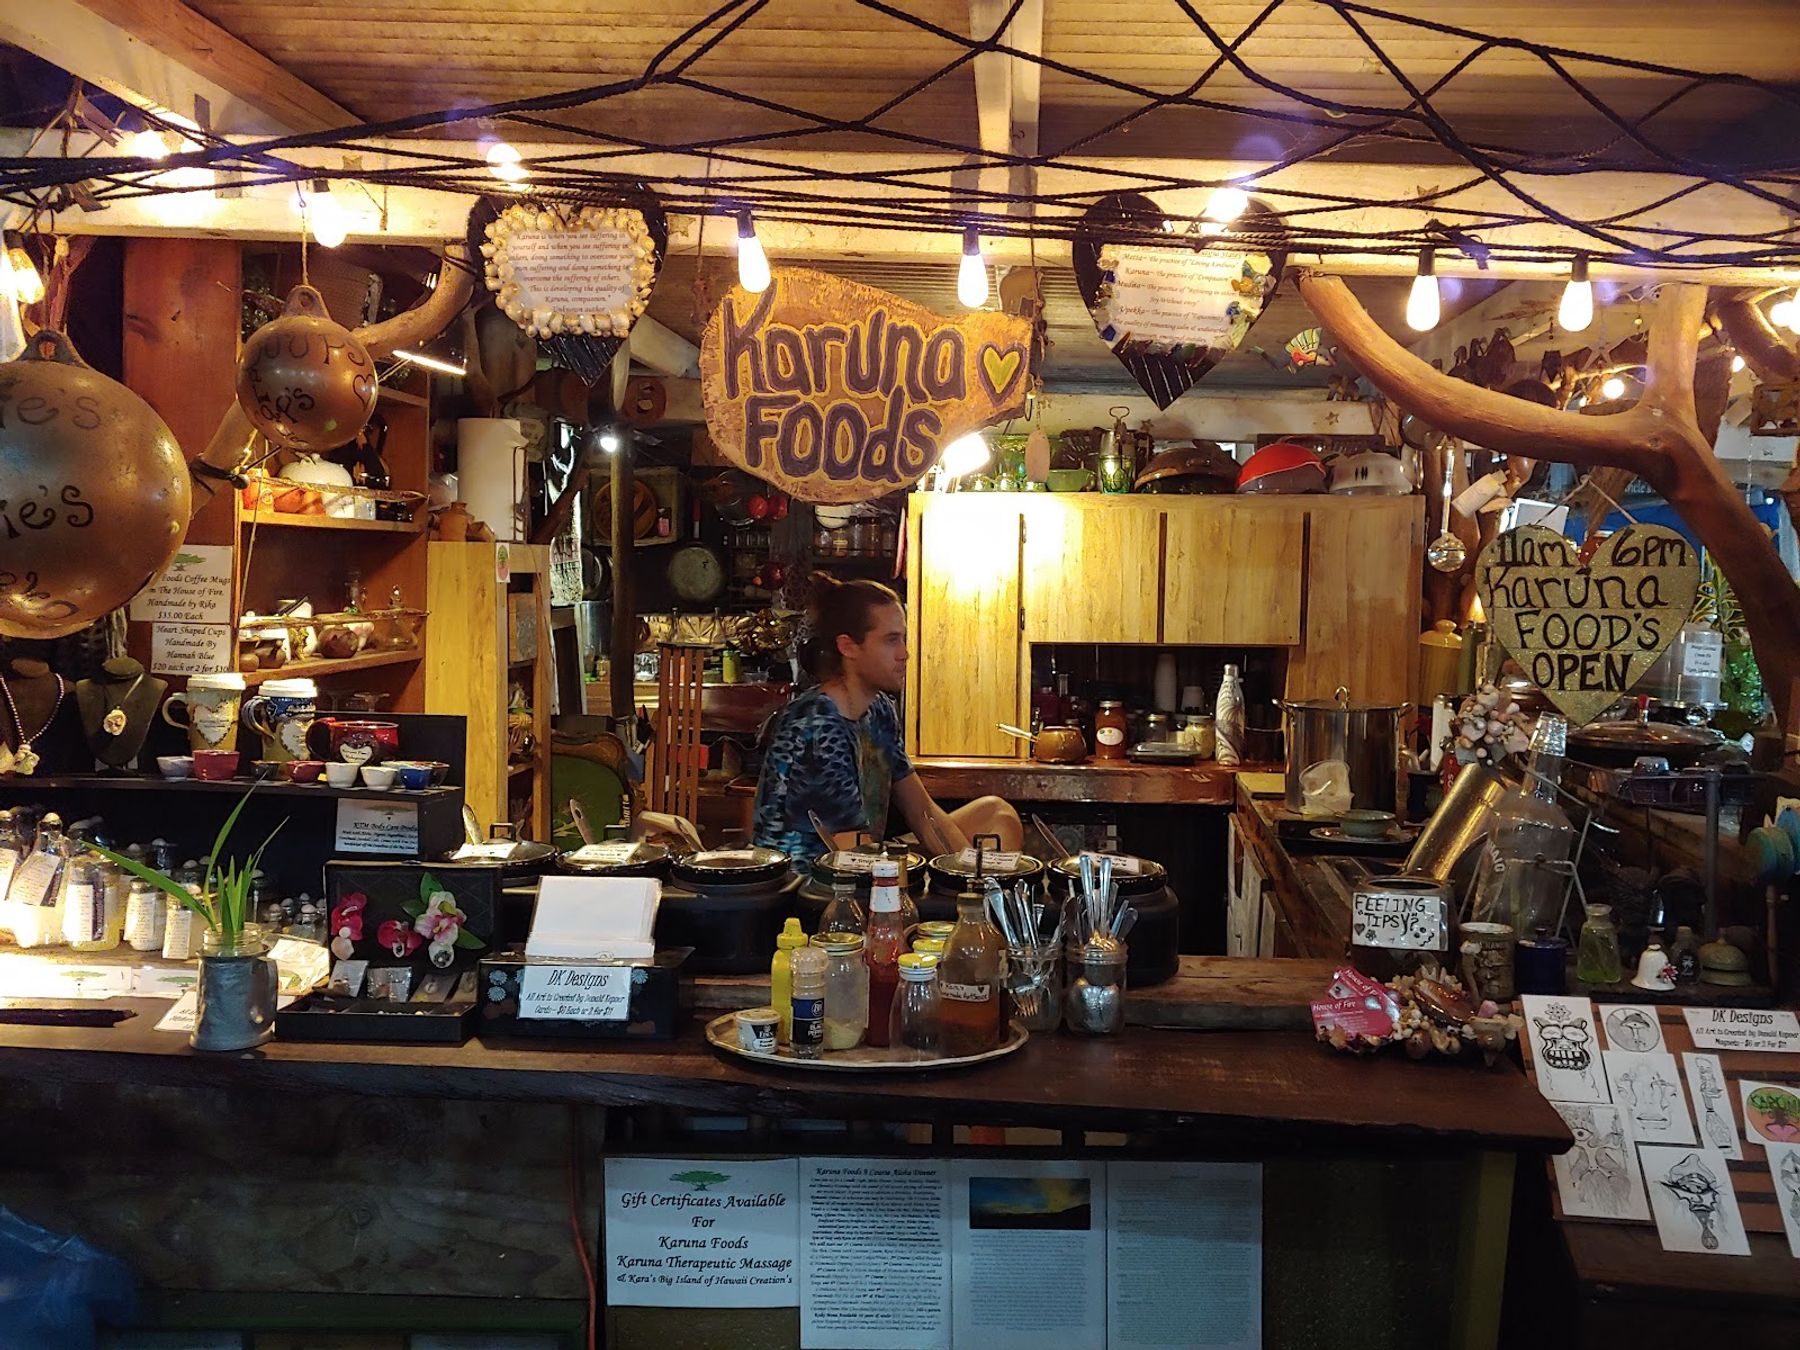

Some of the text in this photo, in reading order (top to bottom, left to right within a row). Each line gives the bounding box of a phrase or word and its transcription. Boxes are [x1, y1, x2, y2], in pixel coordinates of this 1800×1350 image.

[551, 242, 567, 250] when
[592, 241, 620, 251] suffering
[549, 252, 580, 261] something
[529, 263, 557, 273] suffering
[571, 264, 588, 272] doing
[590, 264, 621, 272] something
[564, 273, 591, 283] suffering
[592, 273, 600, 282] of
[529, 283, 542, 291] This
[550, 284, 583, 293] developing
[594, 283, 617, 293] quality
[722, 278, 967, 404] Karuna
[184, 574, 208, 584] Coffee
[209, 576, 231, 585] Mugs
[159, 586, 172, 594] The
[172, 587, 195, 596] House
[197, 588, 205, 597] of
[147, 599, 187, 608] Handmade
[187, 599, 197, 610] by
[184, 611, 203, 620] Each
[156, 625, 226, 638] Heart Shaped Cups
[164, 638, 217, 650] Handmade By
[166, 651, 215, 660] Hannah Blue
[152, 662, 167, 671] $20
[168, 662, 184, 670] each
[194, 664, 199, 672] 2
[201, 664, 212, 673] for
[1531, 651, 1634, 692] OPEN
[1355, 894, 1426, 914] FEELING
[546, 969, 610, 990] DK Designs
[1313, 1003, 1335, 1011] House
[1334, 1002, 1342, 1010] of
[1712, 1009, 1774, 1027] DK Designs
[816, 1167, 841, 1176] Karuna
[842, 1167, 862, 1175] Foods
[621, 1191, 787, 1210] Gift Certificates Available
[691, 1216, 716, 1228] For
[658, 1235, 749, 1250] Karuna Foods
[616, 1255, 793, 1272] Karuna Therapeutic Massage
[628, 1273, 657, 1285] Kara's
[657, 1274, 674, 1287] Big
[675, 1274, 702, 1285] Island
[703, 1274, 714, 1288] of
[714, 1274, 748, 1286] Hawaii
[749, 1274, 793, 1286] Creation's
